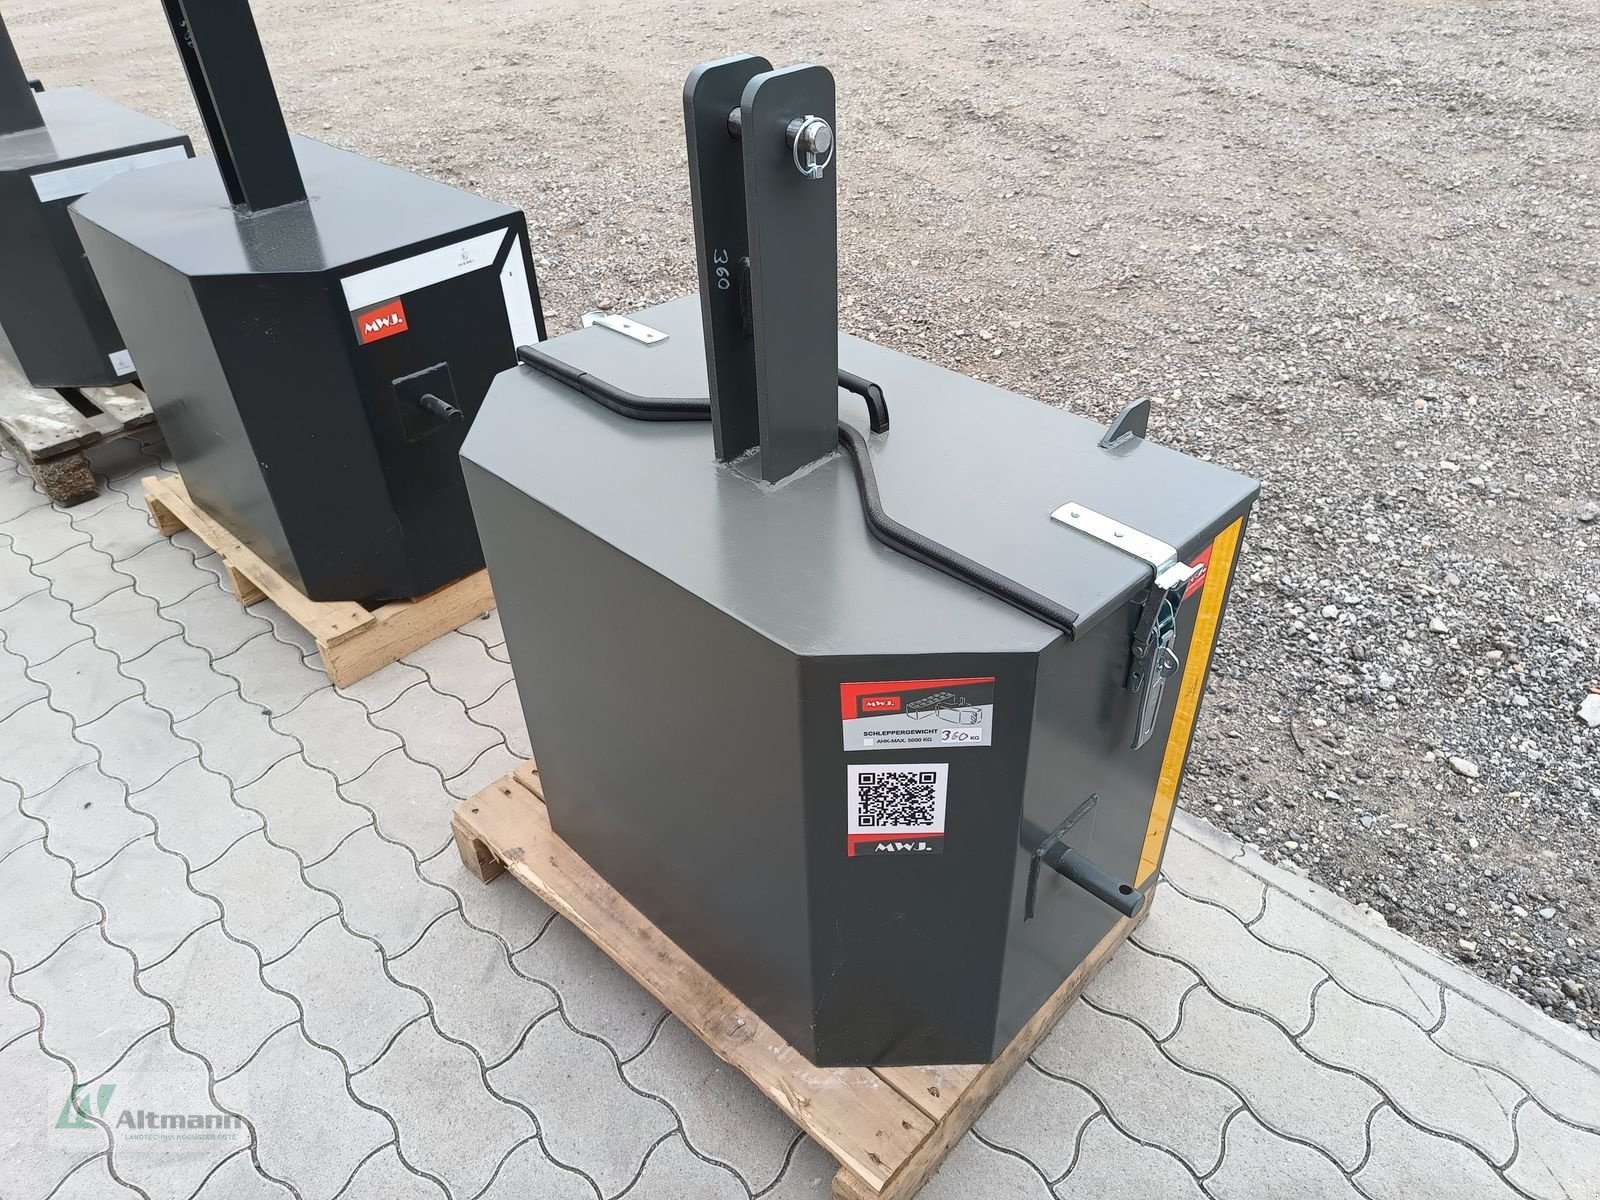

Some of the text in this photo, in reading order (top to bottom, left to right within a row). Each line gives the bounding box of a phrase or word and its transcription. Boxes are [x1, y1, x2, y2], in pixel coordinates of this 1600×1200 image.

[713, 248, 730, 290] 360
[863, 728, 939, 737] SCHLEPPERGEWICHT
[942, 730, 969, 741] 360
